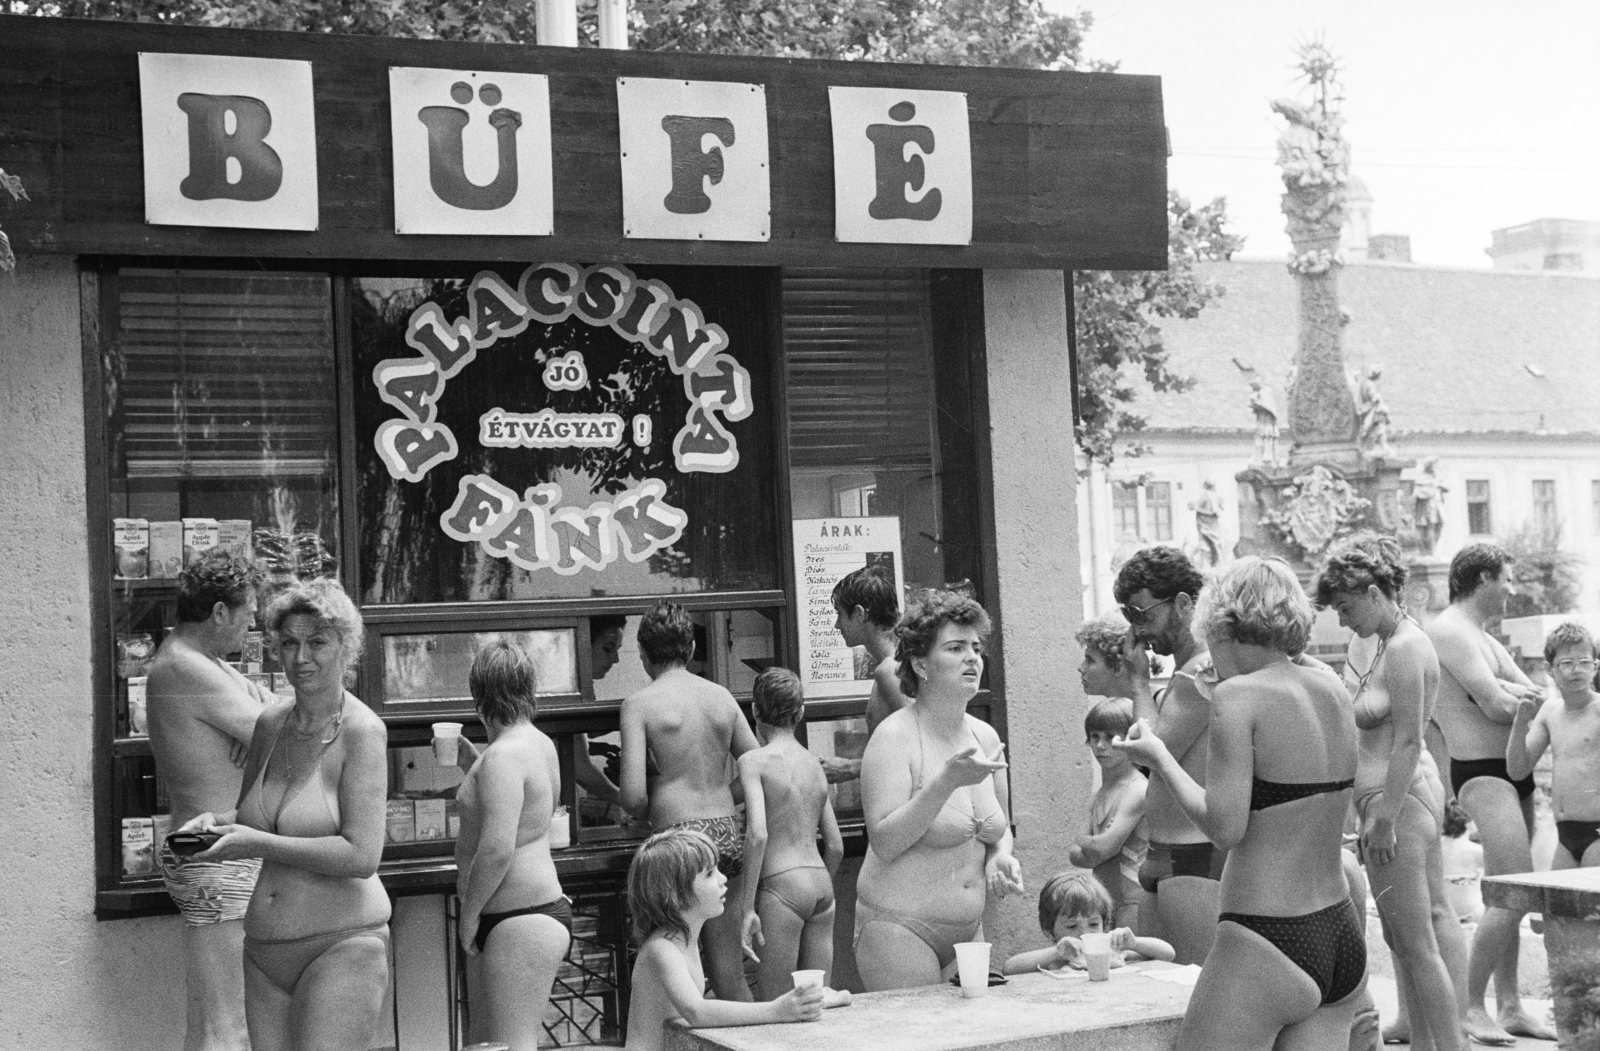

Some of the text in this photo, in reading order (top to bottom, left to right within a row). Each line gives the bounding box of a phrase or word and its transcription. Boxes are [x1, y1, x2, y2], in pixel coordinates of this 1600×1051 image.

[177, 80, 943, 221] BÜFÉ
[374, 262, 753, 482] PALACSINTA
[548, 357, 582, 384] JÓ
[486, 414, 618, 440] ÉTVÁGYAT
[440, 474, 688, 575] FÁNK
[820, 522, 870, 537] ÁRAK:
[808, 597, 830, 605] Sima
[808, 606, 834, 617] Sajtos
[809, 628, 842, 637] Szendvi
[810, 650, 830, 658] Cola
